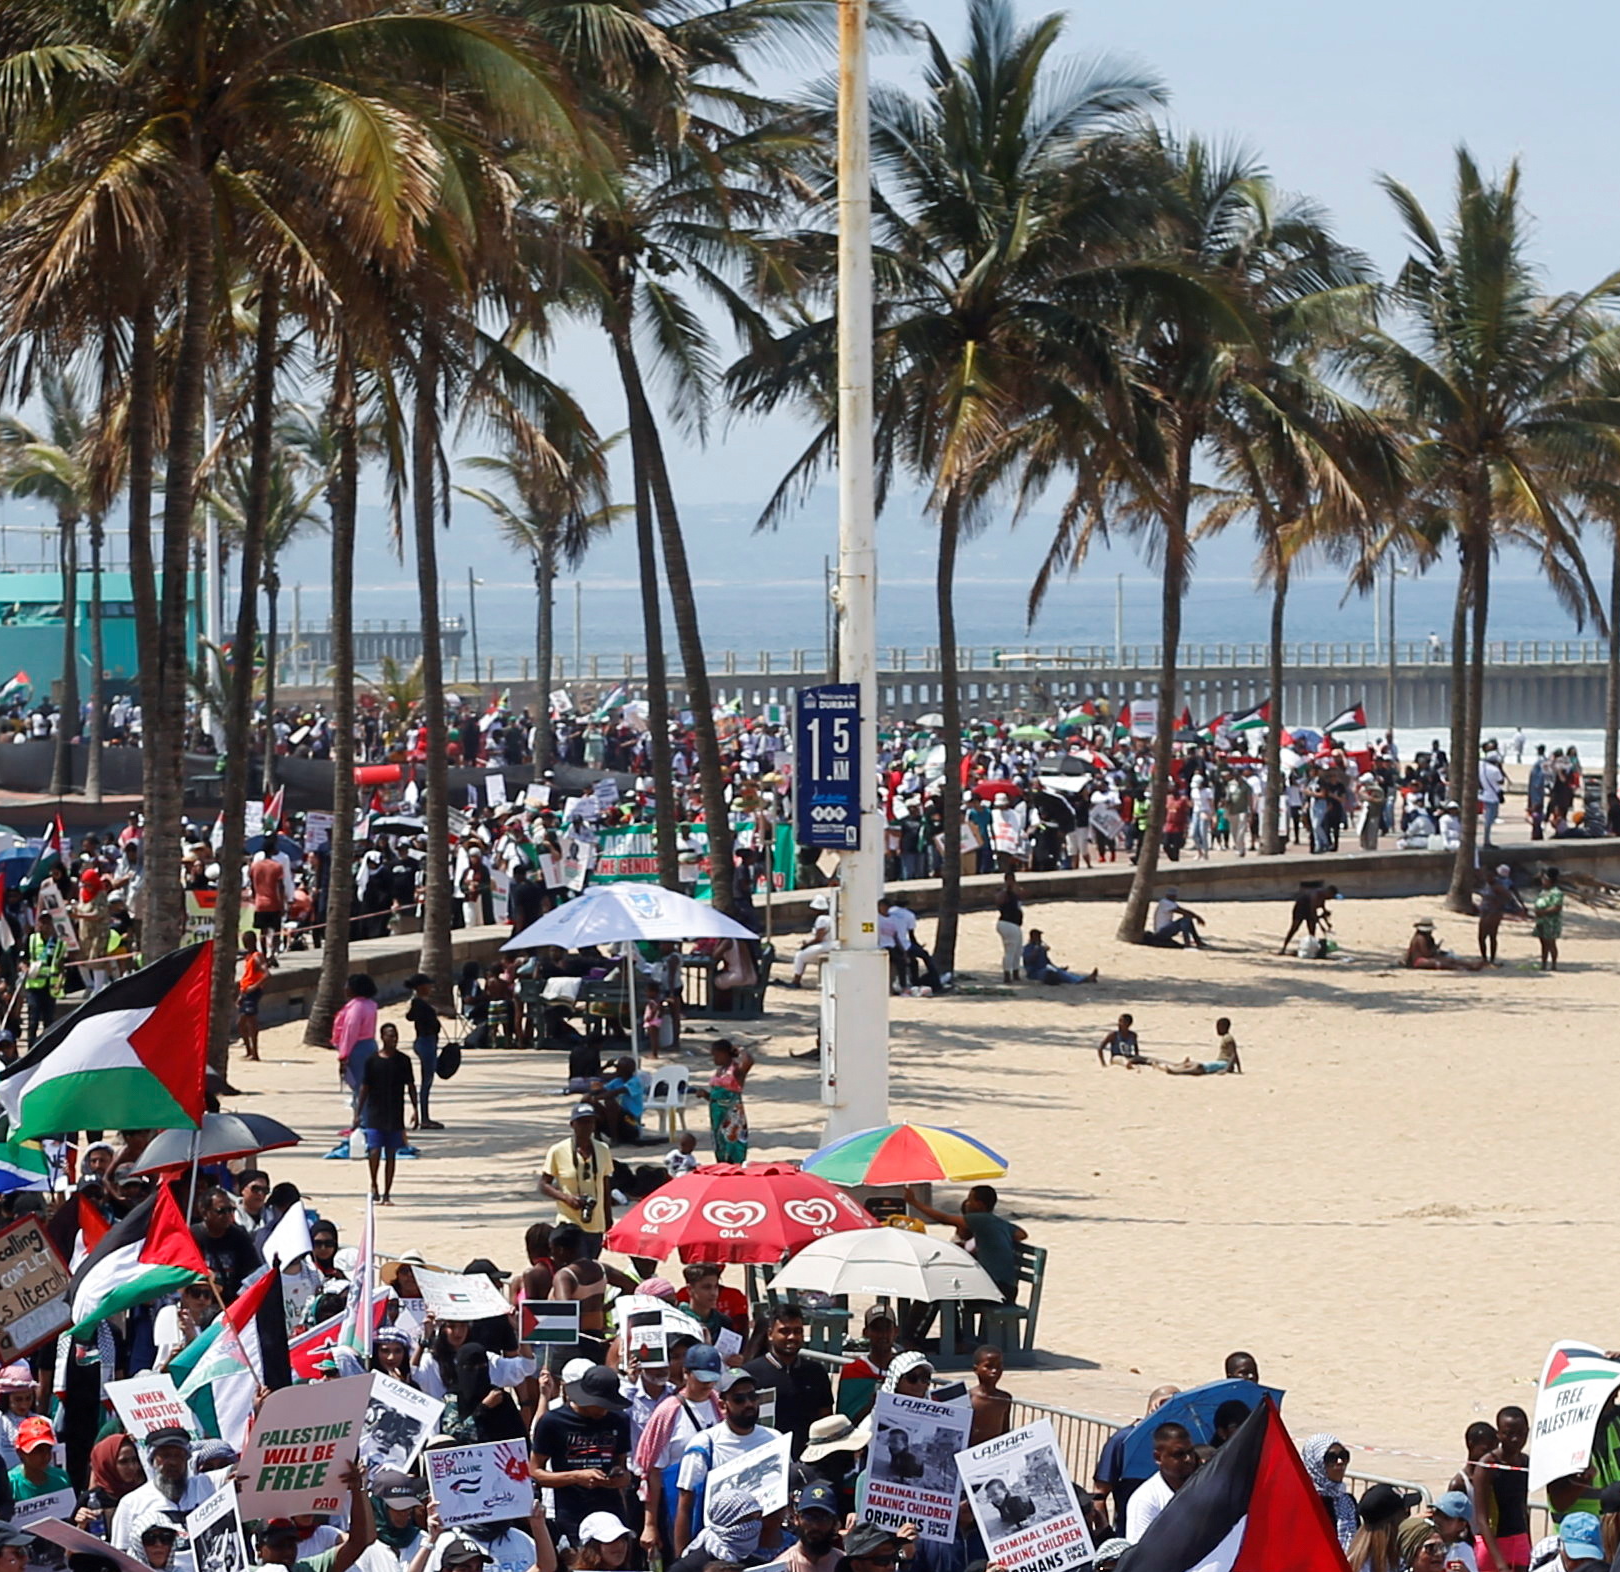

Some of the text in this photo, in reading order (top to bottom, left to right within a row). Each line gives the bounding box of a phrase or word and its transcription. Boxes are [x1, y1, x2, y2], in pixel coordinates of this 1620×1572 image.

[819, 700, 856, 709] DURBAN
[833, 759, 850, 781] KM
[133, 1390, 166, 1405] WHEN
[892, 1397, 956, 1418] LAJPAAL
[1556, 1386, 1586, 1409] FREE
[131, 1402, 184, 1420] INJUSTICE
[1535, 1403, 1598, 1441] PALESTINE!
[257, 1420, 355, 1448] PALESTINE
[972, 1430, 1036, 1460] LAJPAAL
[263, 1443, 336, 1465] WILL BE
[256, 1462, 330, 1493] FREE
[312, 1496, 339, 1511] PAO
[869, 1482, 954, 1507] CRIMINAL ISRAEL
[867, 1493, 952, 1521] MAKING CHILDREN
[993, 1516, 1079, 1556] CRIMINAL ISRAEL
[1037, 1527, 1084, 1556] CHILDREN
